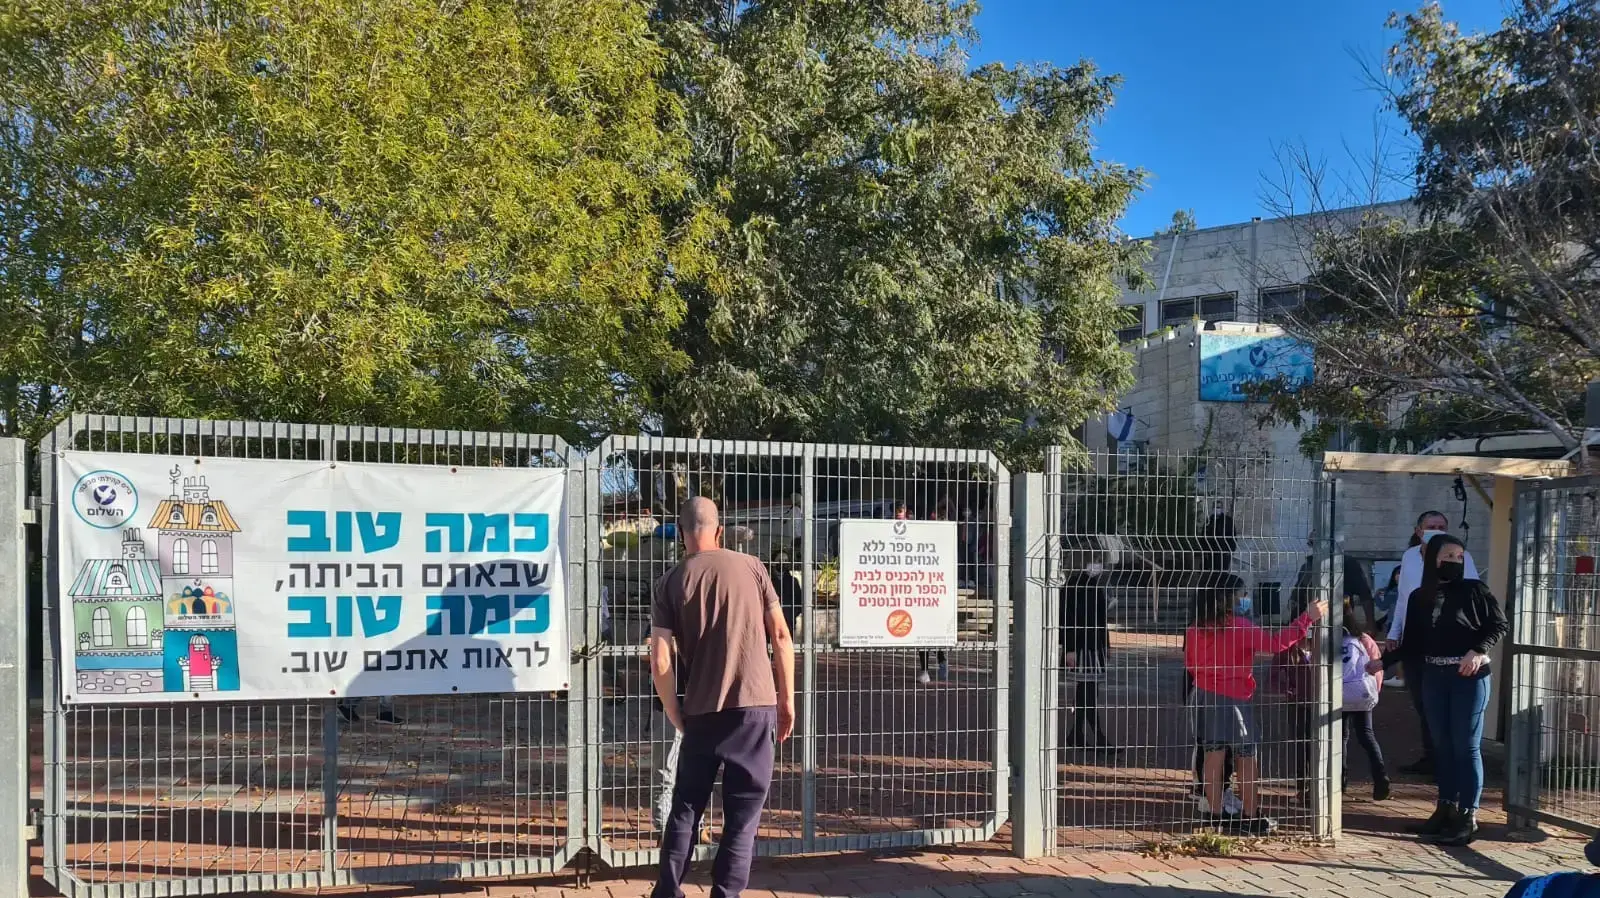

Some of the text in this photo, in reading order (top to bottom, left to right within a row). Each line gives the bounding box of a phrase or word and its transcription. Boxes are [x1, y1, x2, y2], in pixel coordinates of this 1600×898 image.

[87, 505, 123, 517] השלום
[287, 510, 549, 554] כמה טוב
[862, 540, 936, 553] בית ספר ללא
[859, 554, 939, 566] אגוזים ובוטנים
[275, 563, 549, 592] שבאתם הביתה,
[854, 569, 944, 584] אין להכניס לבית
[851, 582, 947, 596] הספר מזון המכיל
[859, 597, 939, 607] אגוזים ובוטנים
[287, 594, 550, 638] כמה טוב
[281, 641, 550, 673] לראות אתכם שוב.
